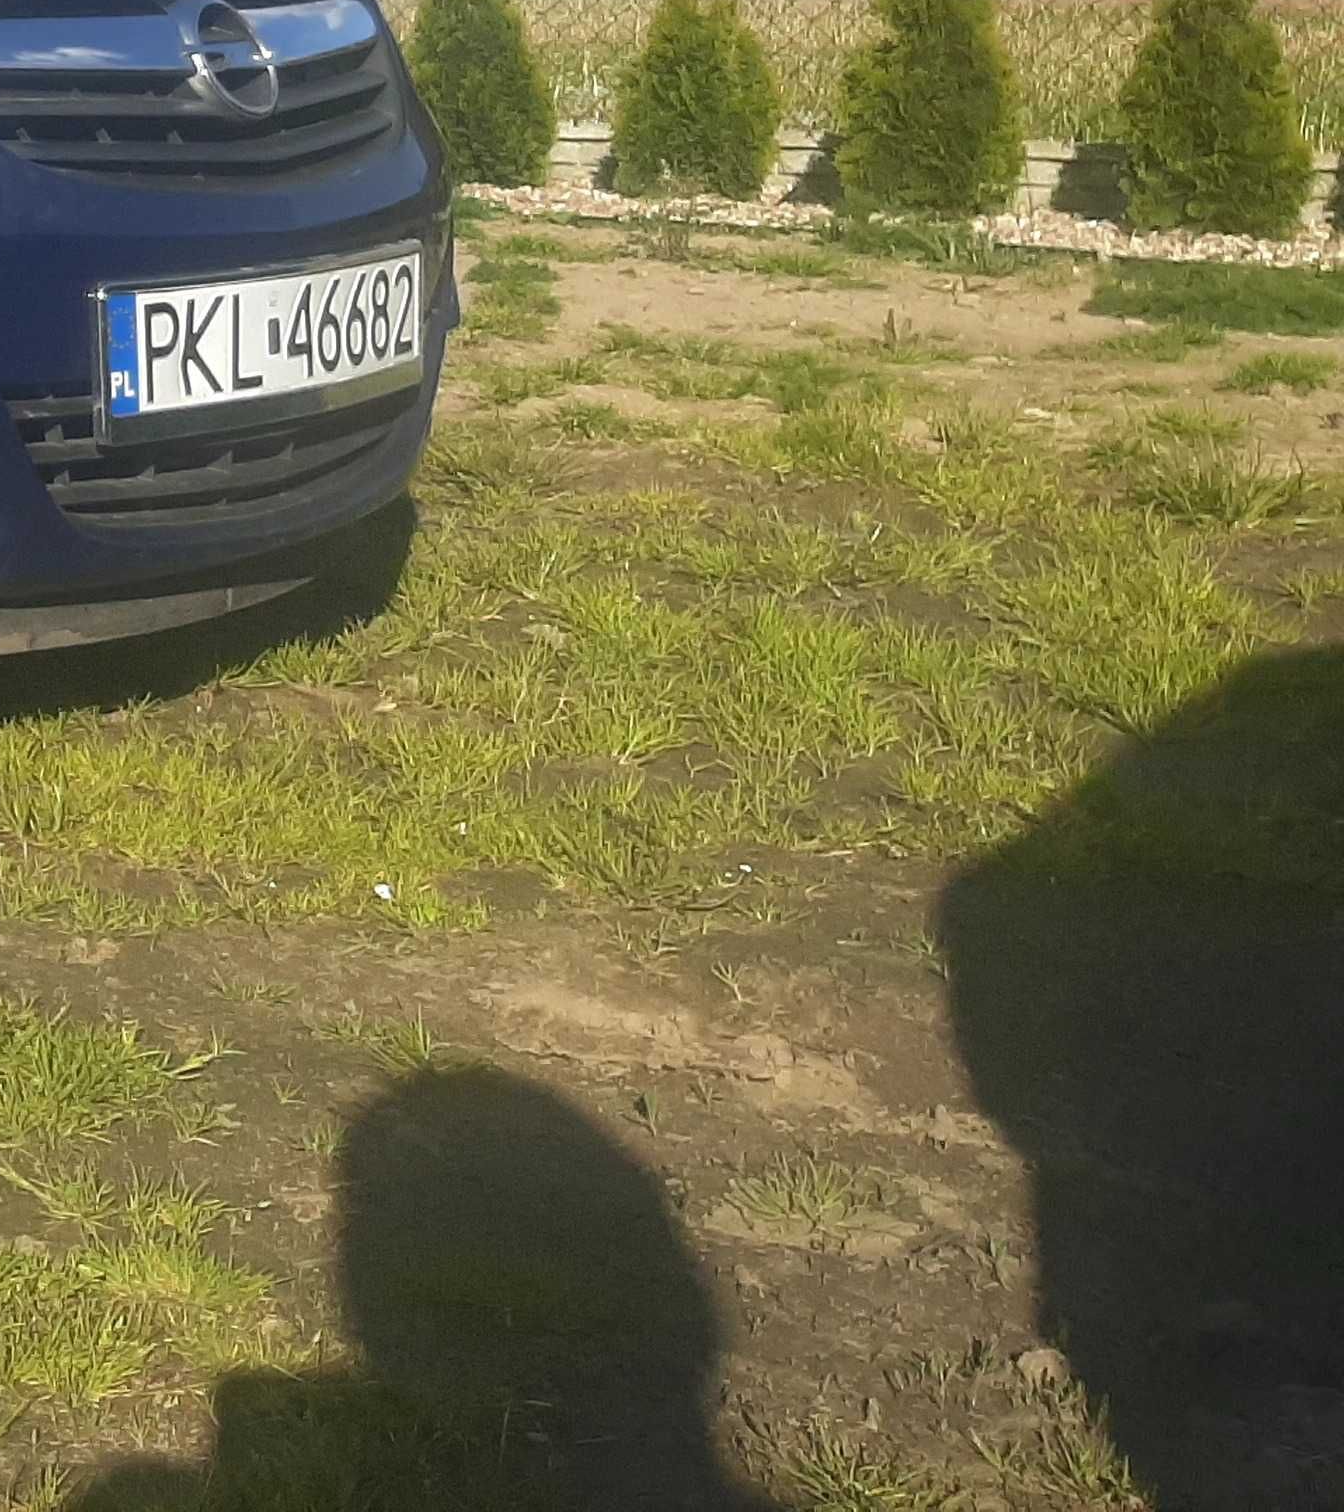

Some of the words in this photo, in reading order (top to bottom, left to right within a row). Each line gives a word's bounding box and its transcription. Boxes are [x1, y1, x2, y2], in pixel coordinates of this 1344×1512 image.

[144, 293, 263, 405] PKL
[286, 263, 413, 379] 46682
[110, 370, 135, 399] PL
